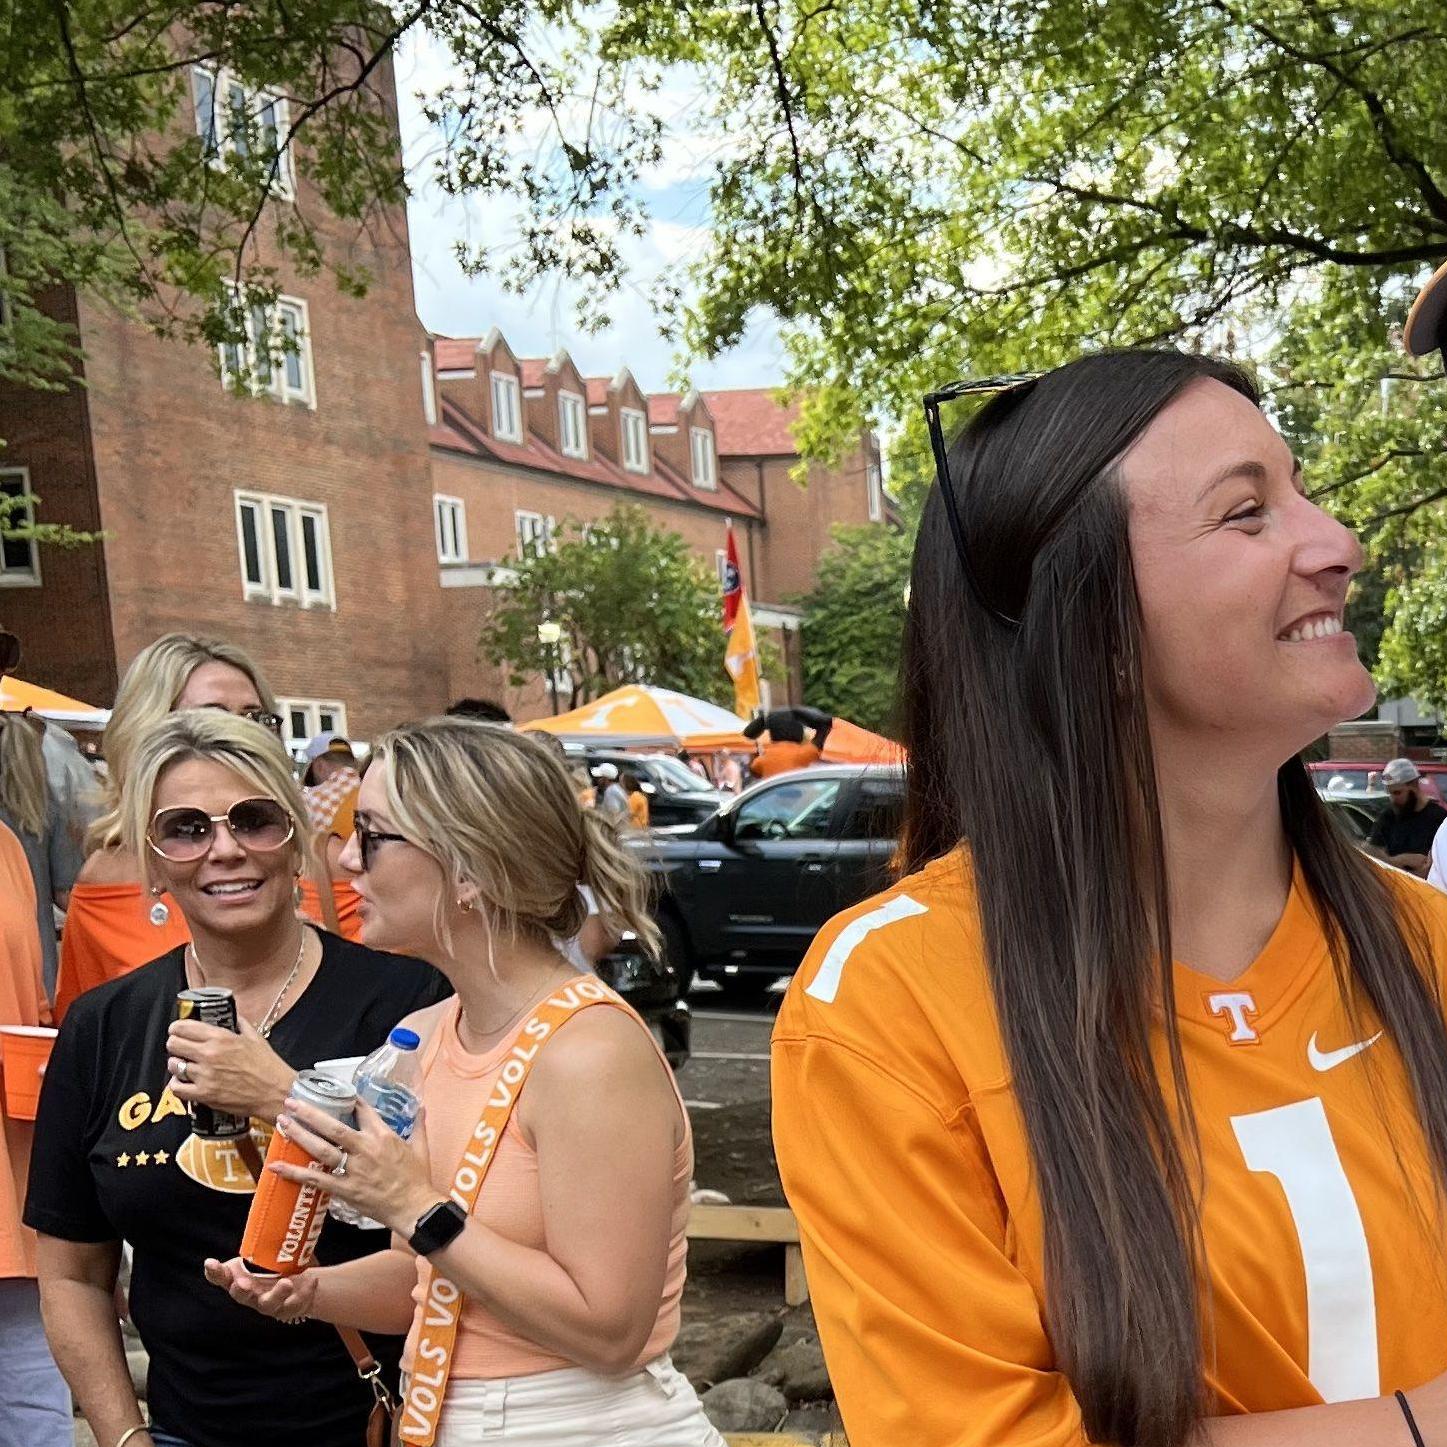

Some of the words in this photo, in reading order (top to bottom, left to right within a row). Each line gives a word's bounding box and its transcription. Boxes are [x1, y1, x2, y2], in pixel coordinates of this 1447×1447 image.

[1207, 991, 1258, 1042] T
[488, 1017, 551, 1109] VOLS
[118, 1085, 187, 1131] GA
[1229, 1096, 1381, 1404] 1
[424, 1277, 460, 1328] VO
[403, 1338, 447, 1436] VOLS
